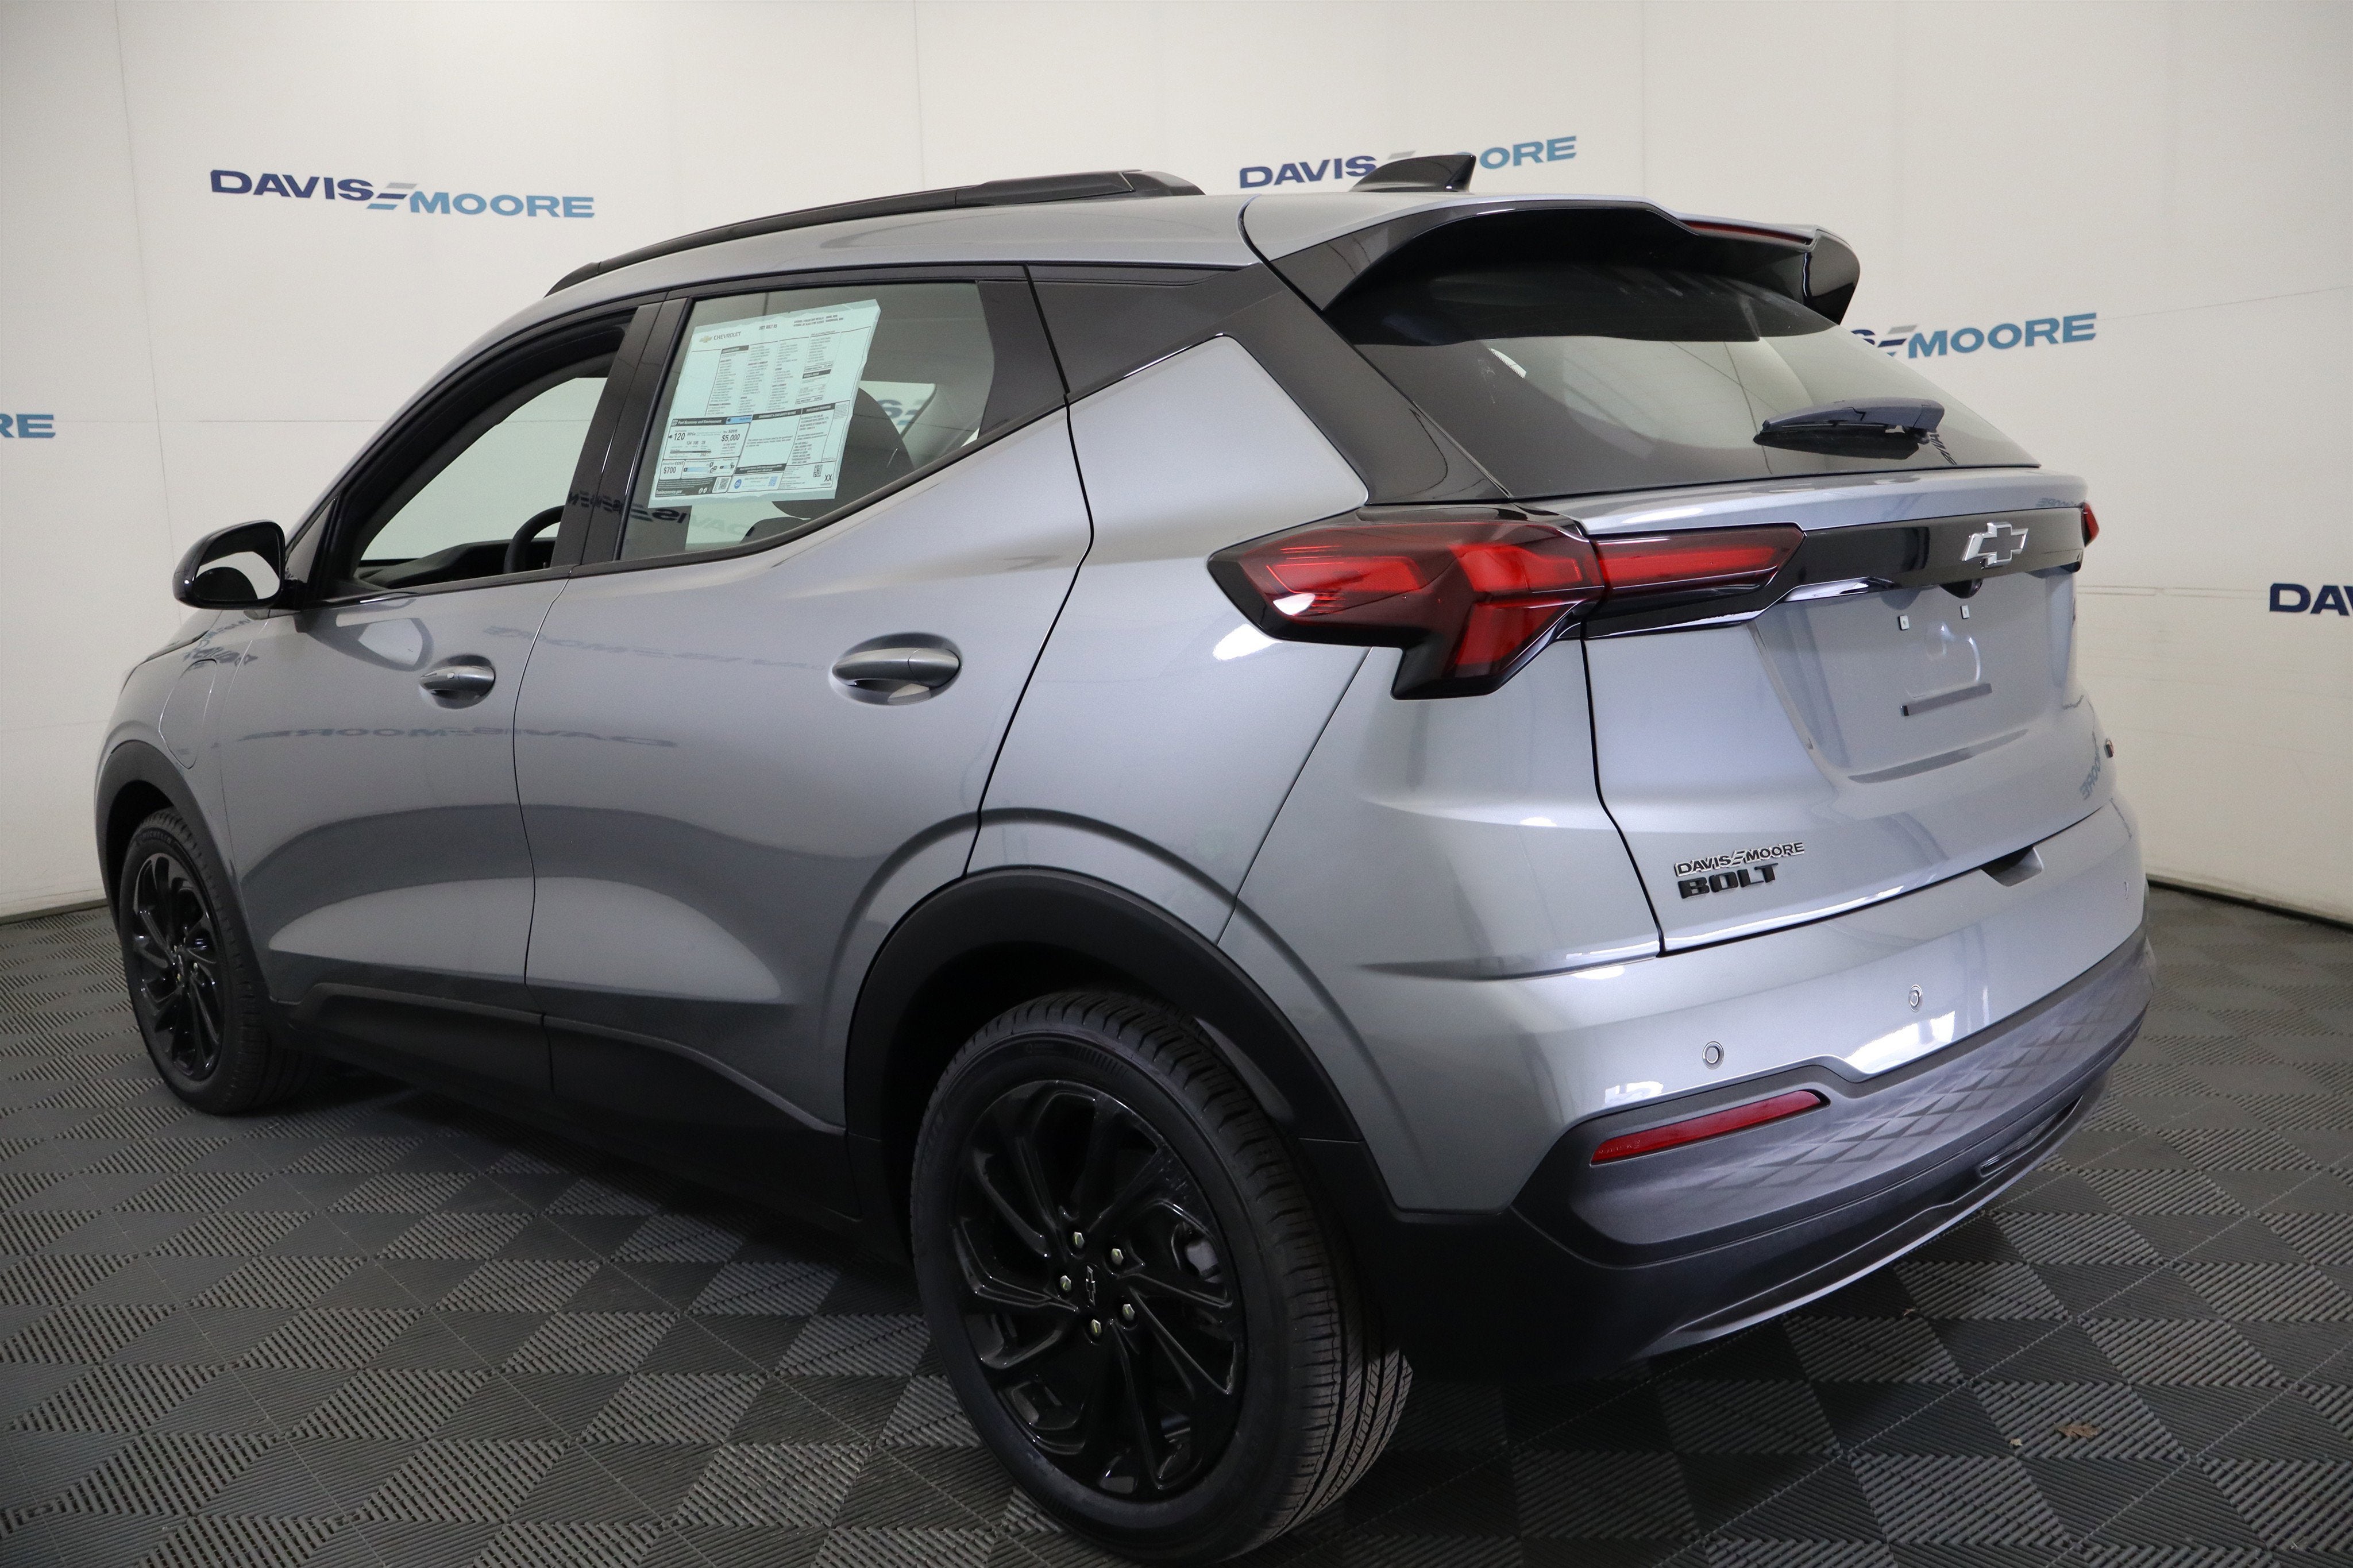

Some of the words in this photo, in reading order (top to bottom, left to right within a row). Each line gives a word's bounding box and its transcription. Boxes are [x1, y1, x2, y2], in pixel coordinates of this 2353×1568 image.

[210, 169, 374, 201] DAVIS
[409, 191, 595, 218] MOORE
[713, 331, 742, 340] CHEVROLET
[1908, 313, 2097, 358] MOORE
[674, 432, 685, 441] 120
[721, 434, 740, 442] $5,000
[664, 466, 677, 474] $700
[824, 473, 833, 482] XX
[1674, 854, 1731, 876] DAVIS
[1744, 841, 1805, 864] MOORE
[1677, 863, 1779, 899] BOLT
